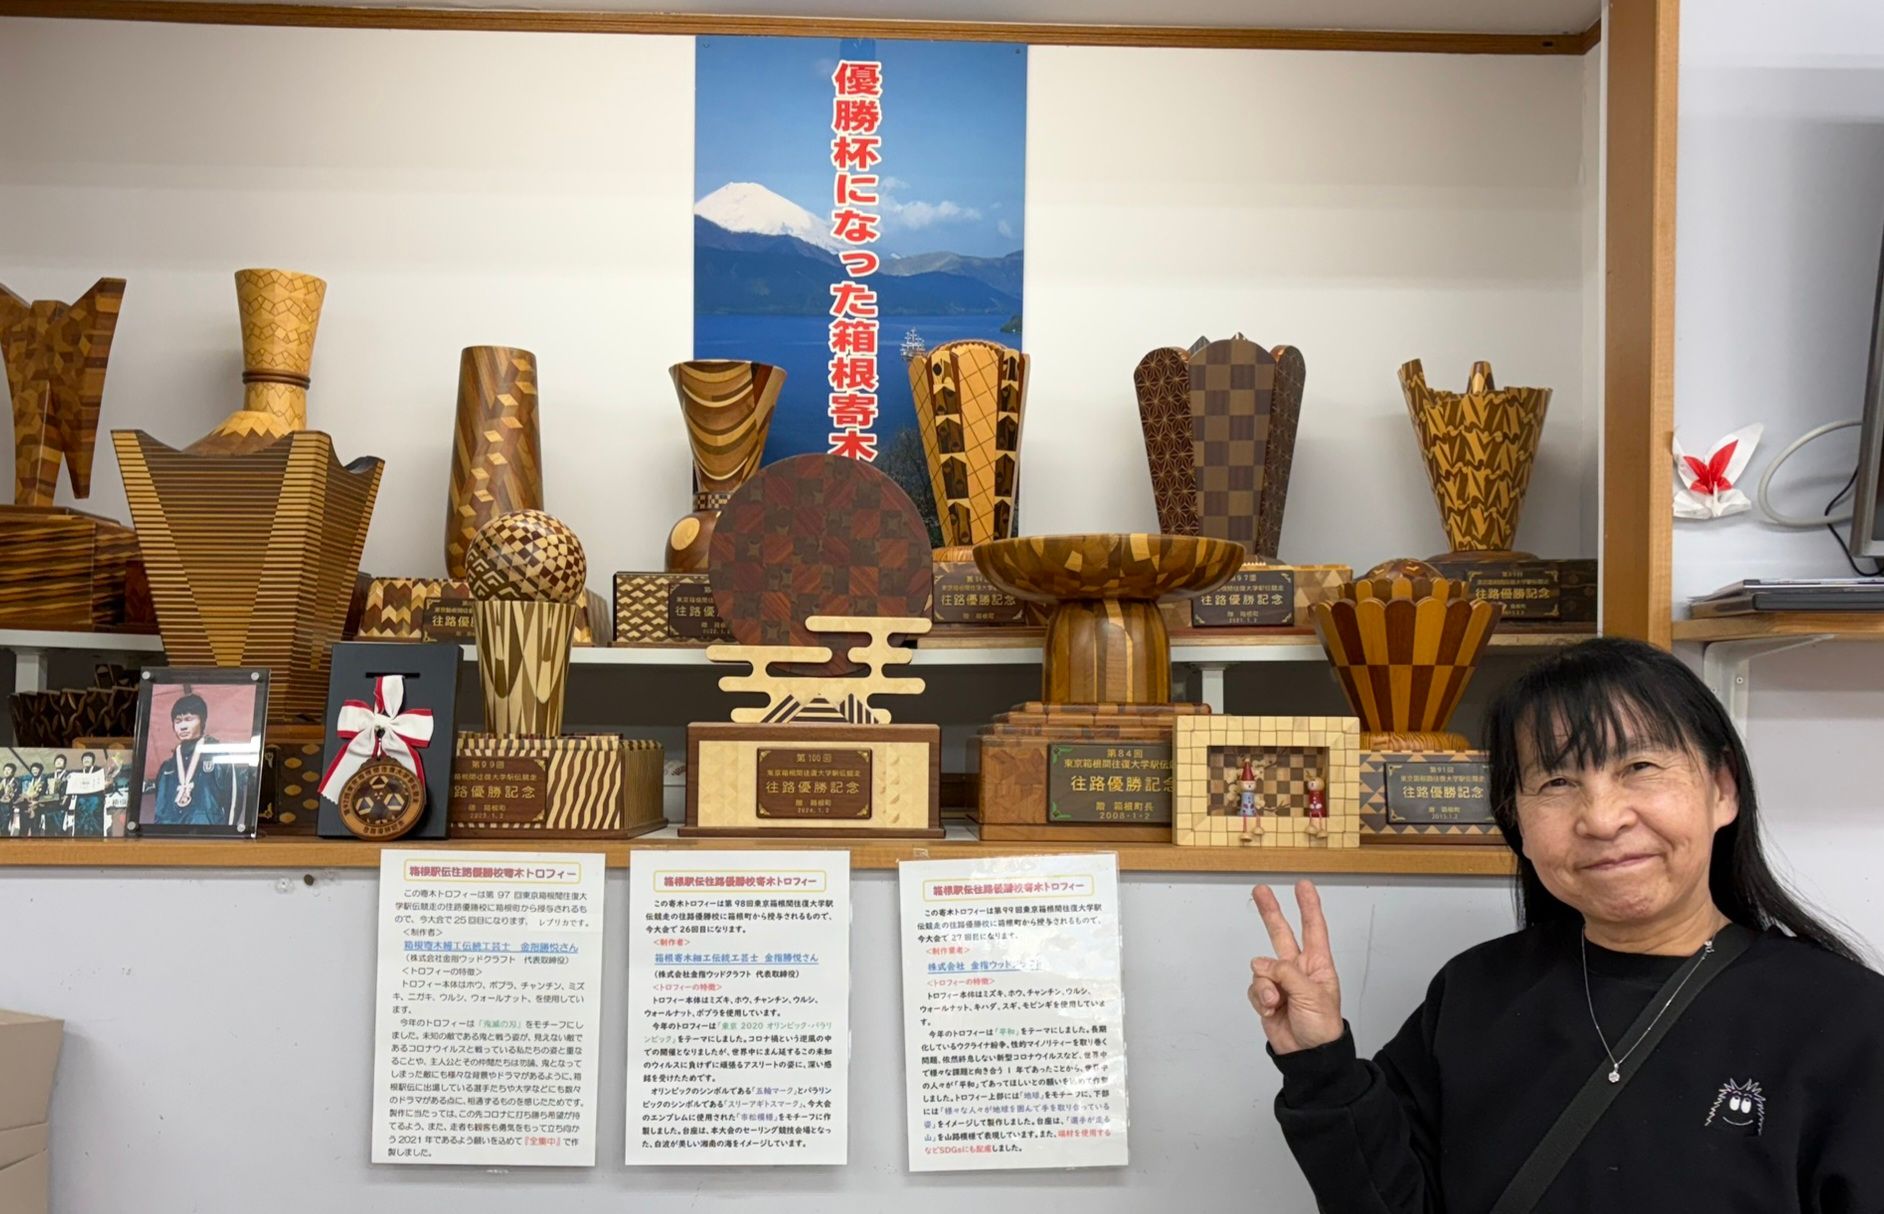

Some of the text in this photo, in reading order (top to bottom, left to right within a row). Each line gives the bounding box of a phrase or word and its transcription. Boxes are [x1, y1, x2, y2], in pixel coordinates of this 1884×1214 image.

[828, 60, 882, 462] 優勝杯になった箱根寄木
[941, 593, 1016, 606] 往路優勝記念
[1201, 594, 1284, 606] 往路優勝記念
[1475, 588, 1551, 600] 往路優勝記念
[675, 606, 720, 617] 往路優
[1106, 748, 1143, 758] 第84回
[1064, 758, 1173, 770] 東京箱根間往復大学駅伝
[766, 781, 860, 794] 往路優勝記念
[1071, 775, 1174, 793] 往路優勝記念
[1403, 785, 1484, 799] 往路優勝記念
[1113, 801, 1154, 811] 箱根町長
